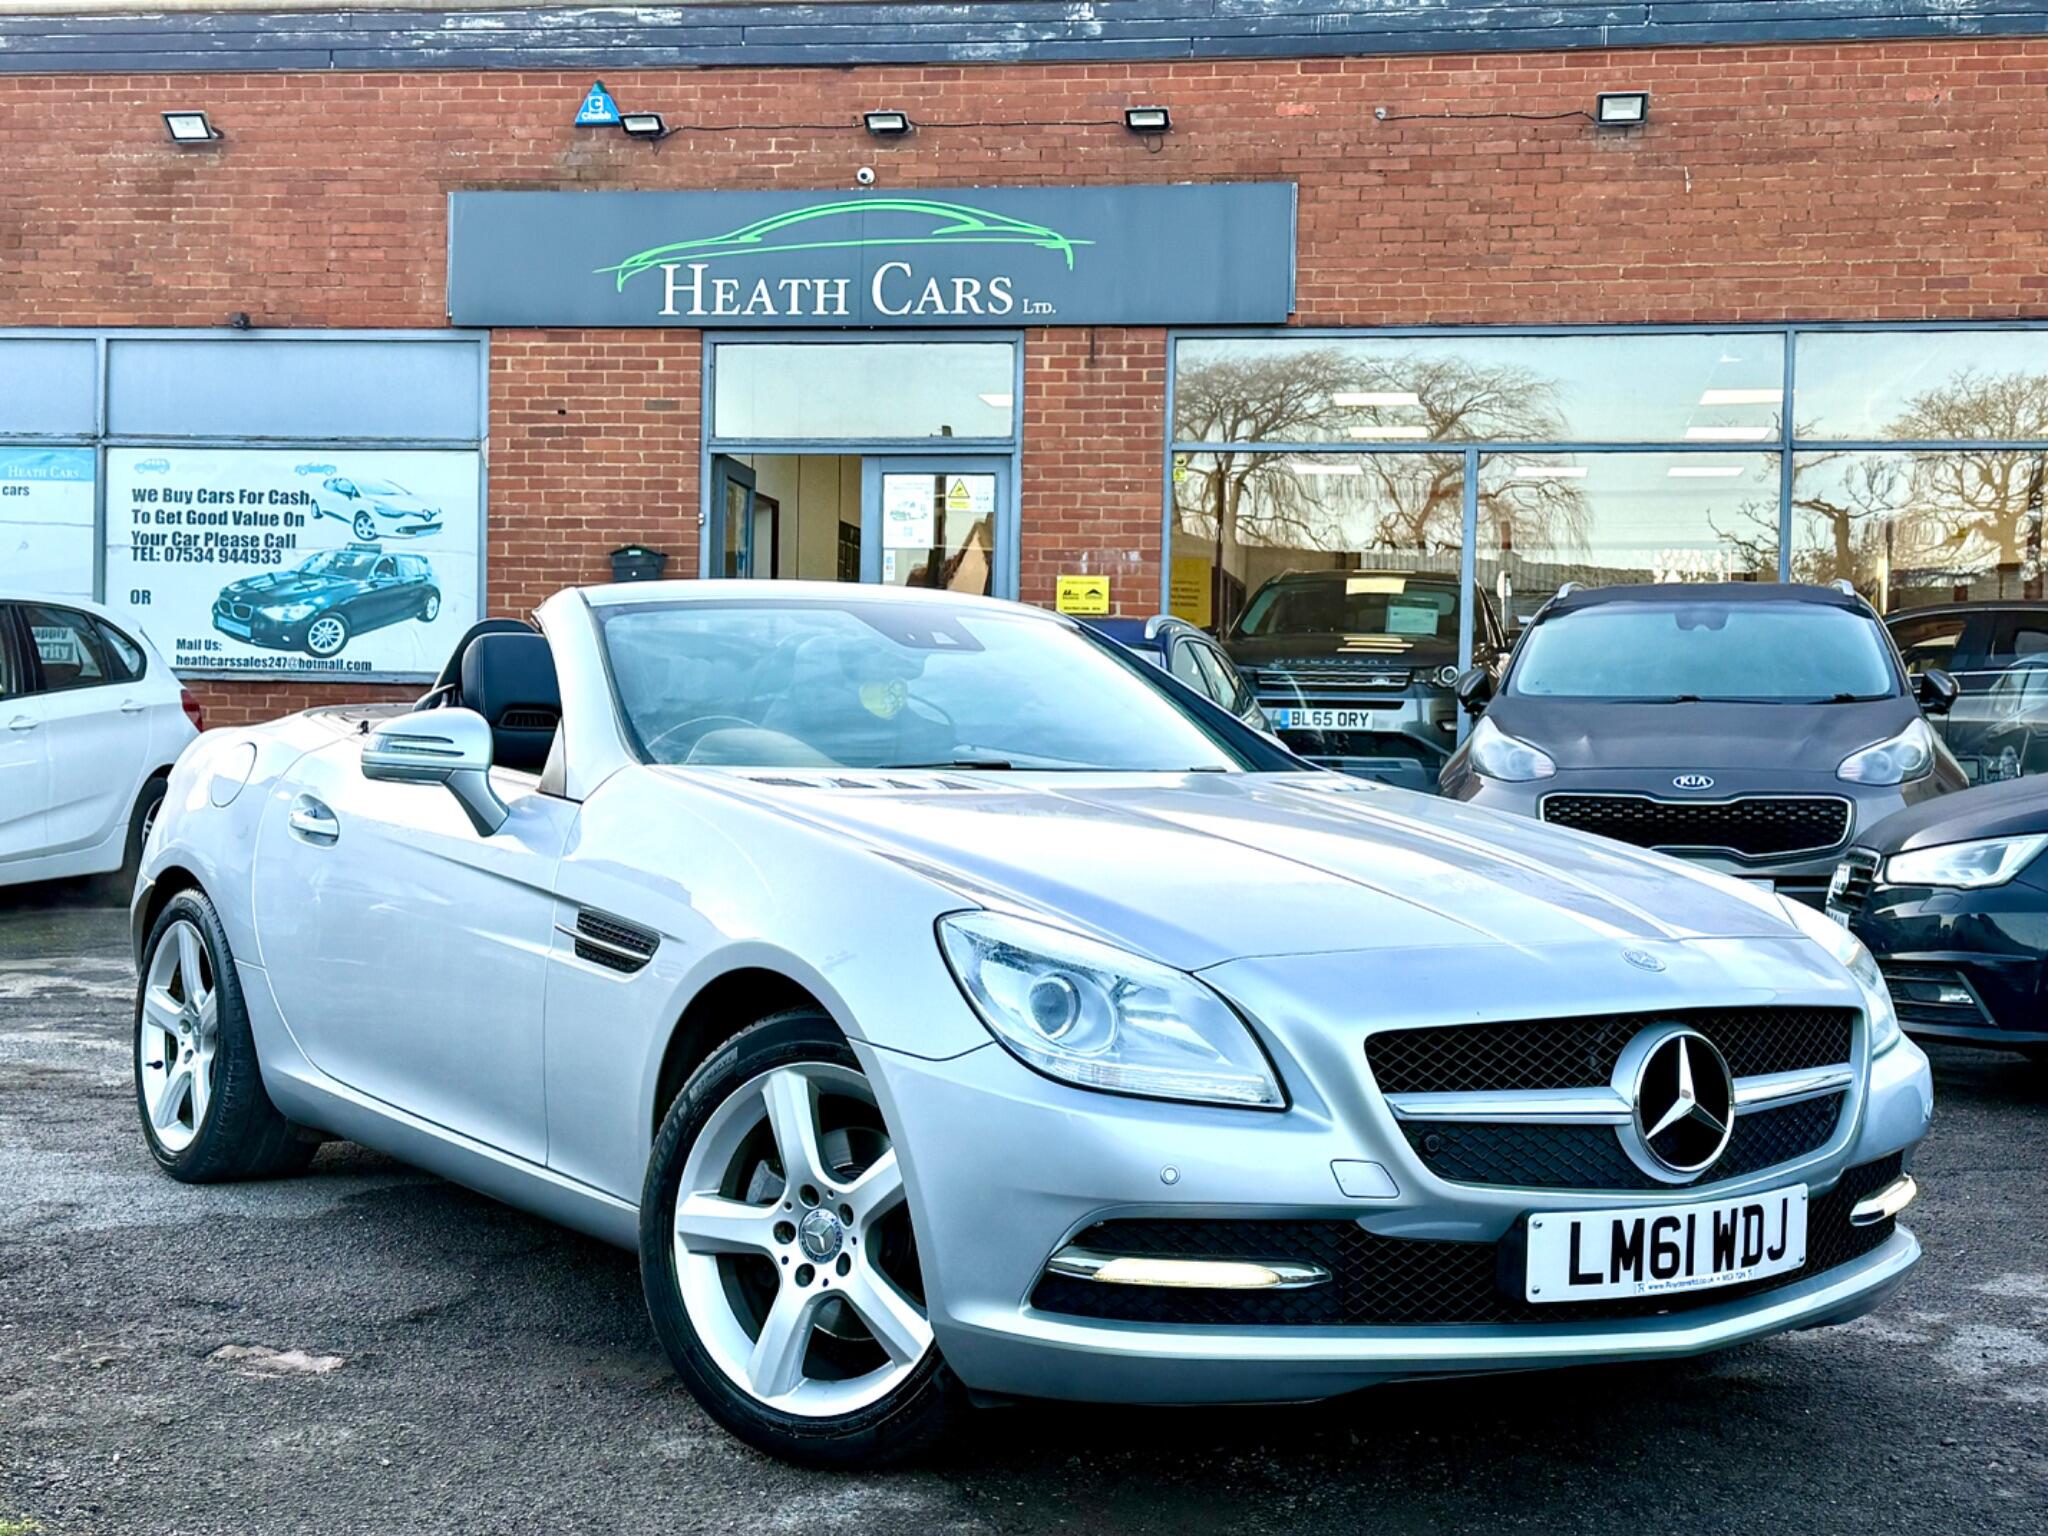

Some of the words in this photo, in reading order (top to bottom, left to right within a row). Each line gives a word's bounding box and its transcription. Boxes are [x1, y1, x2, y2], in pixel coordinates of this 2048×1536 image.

[658, 263, 851, 316] HEATH
[871, 261, 1014, 316] CARS
[8, 465, 47, 478] HEATH
[50, 465, 80, 478] CARS
[2, 486, 30, 496] cars
[162, 488, 193, 505] Buy
[197, 488, 235, 504] Cars
[239, 489, 265, 505] For
[132, 509, 150, 524] To
[155, 509, 182, 525] Get
[186, 510, 228, 526] Good
[232, 510, 279, 527] Value
[284, 511, 305, 527] On
[131, 531, 168, 547] Your
[171, 531, 200, 547] Car
[204, 532, 259, 548] Please
[264, 532, 296, 549] Call
[131, 547, 160, 562] TEL:
[164, 547, 214, 563] 07534
[218, 548, 282, 565] 944933
[130, 589, 151, 605] OR
[176, 639, 201, 651] Mail
[204, 639, 222, 652] Us:
[176, 655, 372, 672] heathcarssales247@hotmail.com
[1291, 711, 1333, 727] BL65
[1680, 775, 1708, 786] KIA
[1569, 1213, 1695, 1285] LM61
[1713, 1198, 1788, 1273] WDJ
